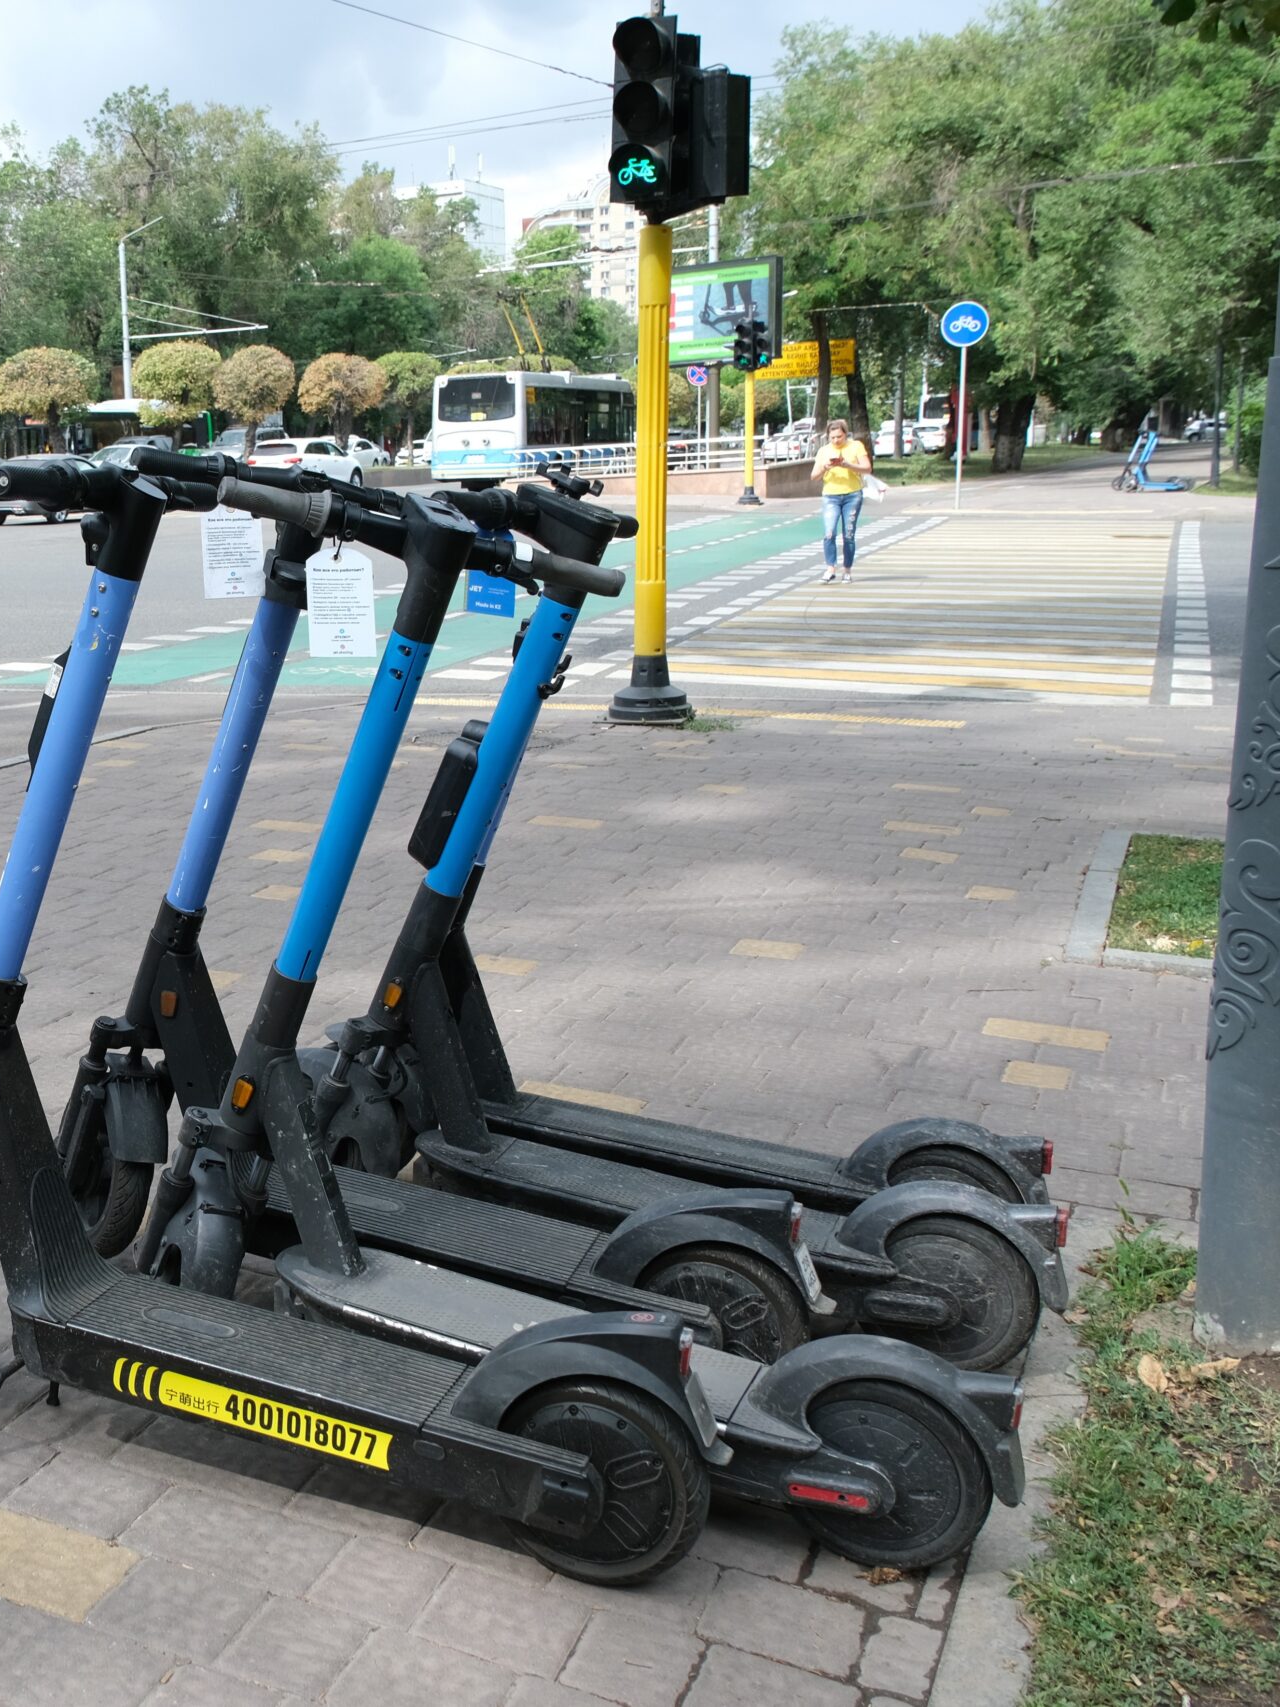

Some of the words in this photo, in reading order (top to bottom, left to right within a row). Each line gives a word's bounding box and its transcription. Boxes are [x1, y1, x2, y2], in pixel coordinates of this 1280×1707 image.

[165, 1388, 220, 1414] 宁萌出行
[225, 1393, 378, 1461] 4001018077
